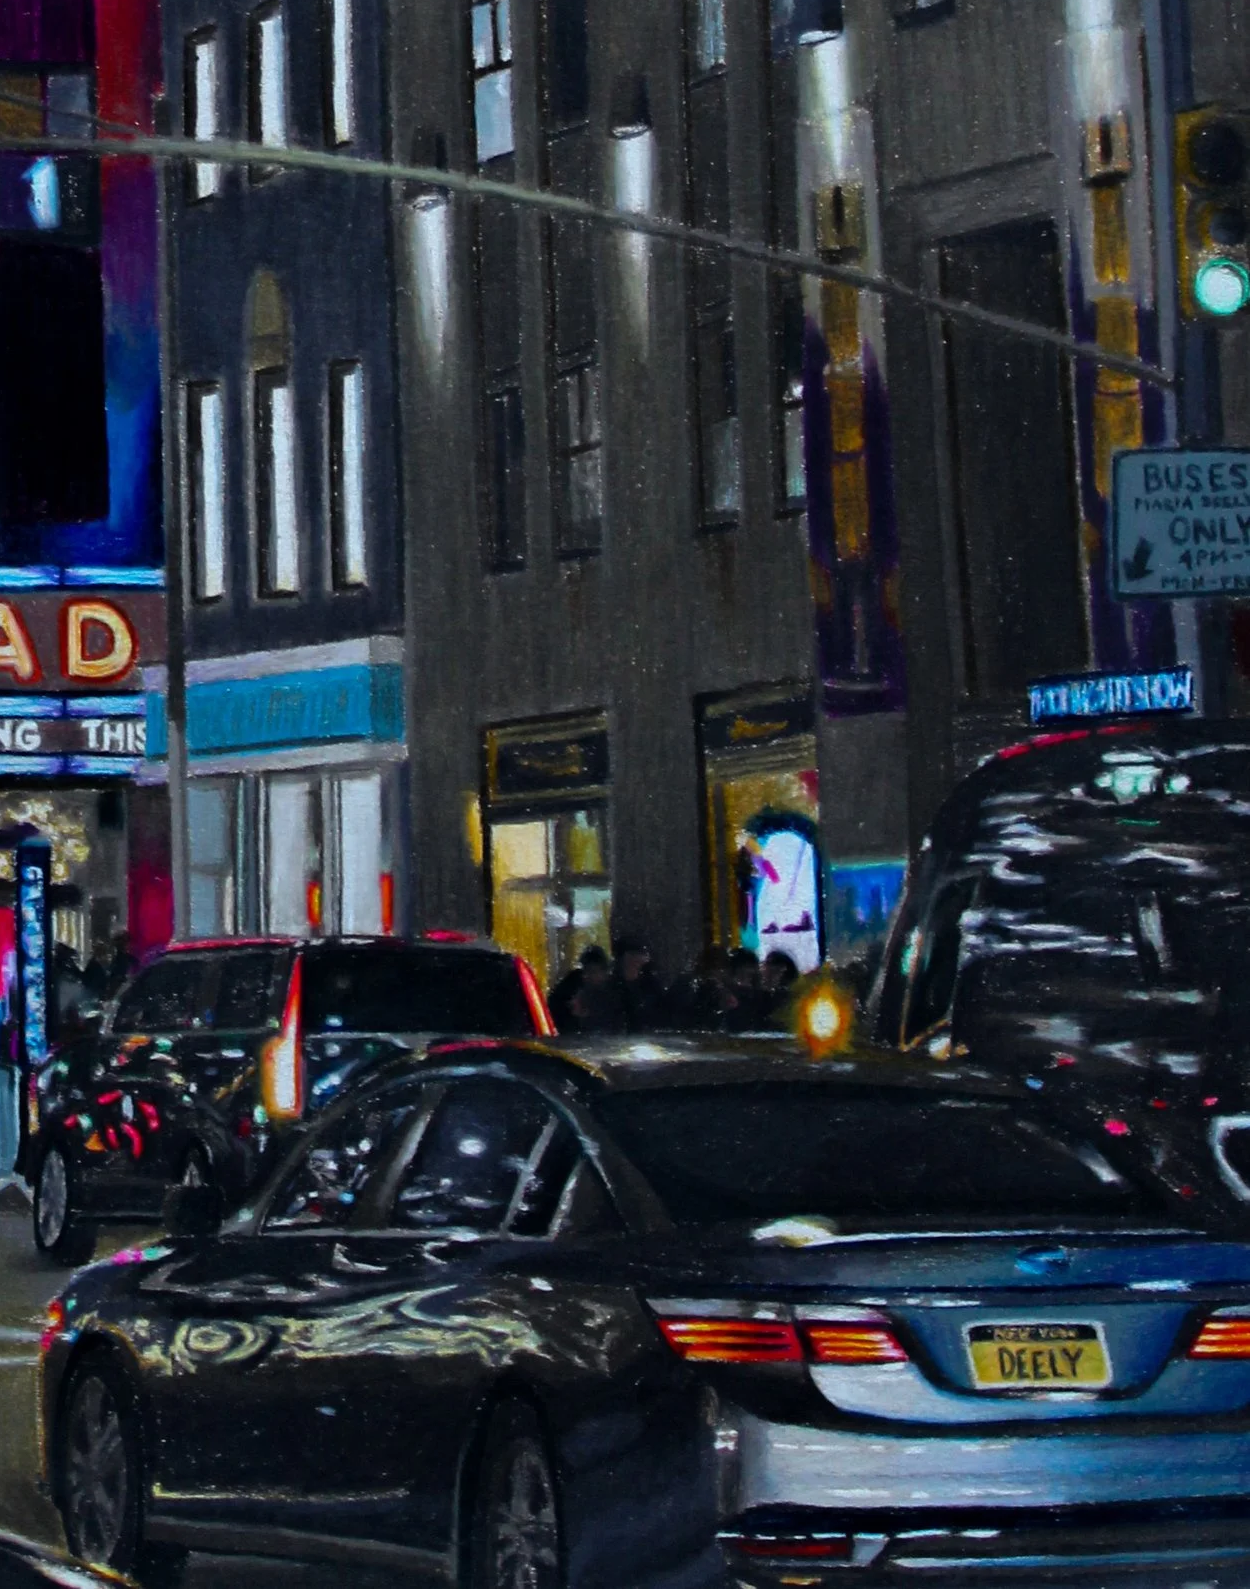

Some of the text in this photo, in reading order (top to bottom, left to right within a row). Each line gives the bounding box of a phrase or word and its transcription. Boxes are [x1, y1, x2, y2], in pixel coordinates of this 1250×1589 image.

[1143, 463, 1248, 494] BUSES
[1168, 514, 1250, 546] ONLY
[997, 1346, 1084, 1380] DEELY
